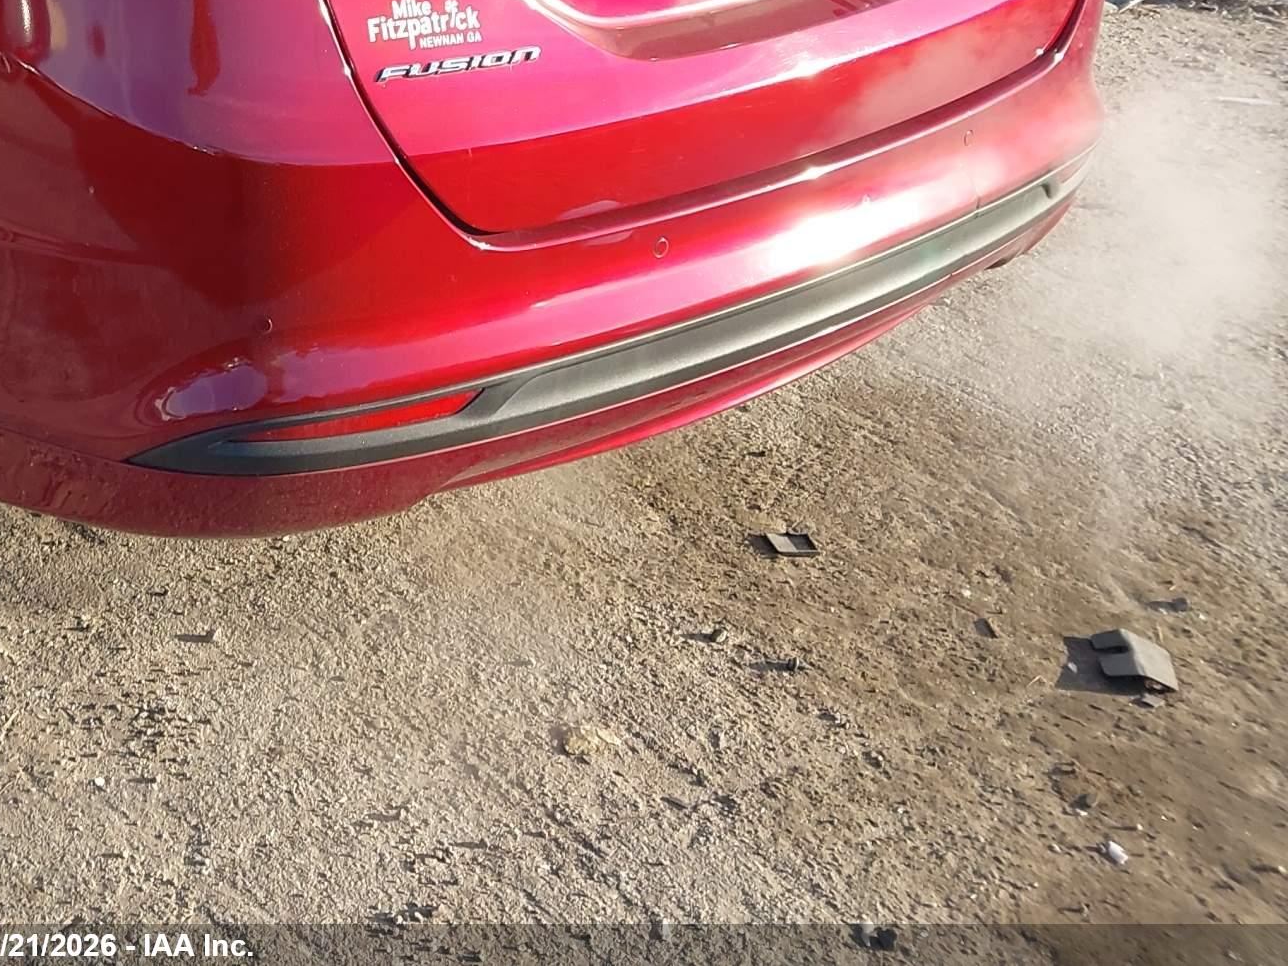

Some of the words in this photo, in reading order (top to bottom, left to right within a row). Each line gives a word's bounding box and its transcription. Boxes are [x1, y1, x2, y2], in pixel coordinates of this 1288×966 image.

[367, 0, 481, 50] Fitzpatrick
[419, 33, 464, 49] NEWNAN
[466, 30, 482, 44] GA
[376, 46, 542, 82] FUSION
